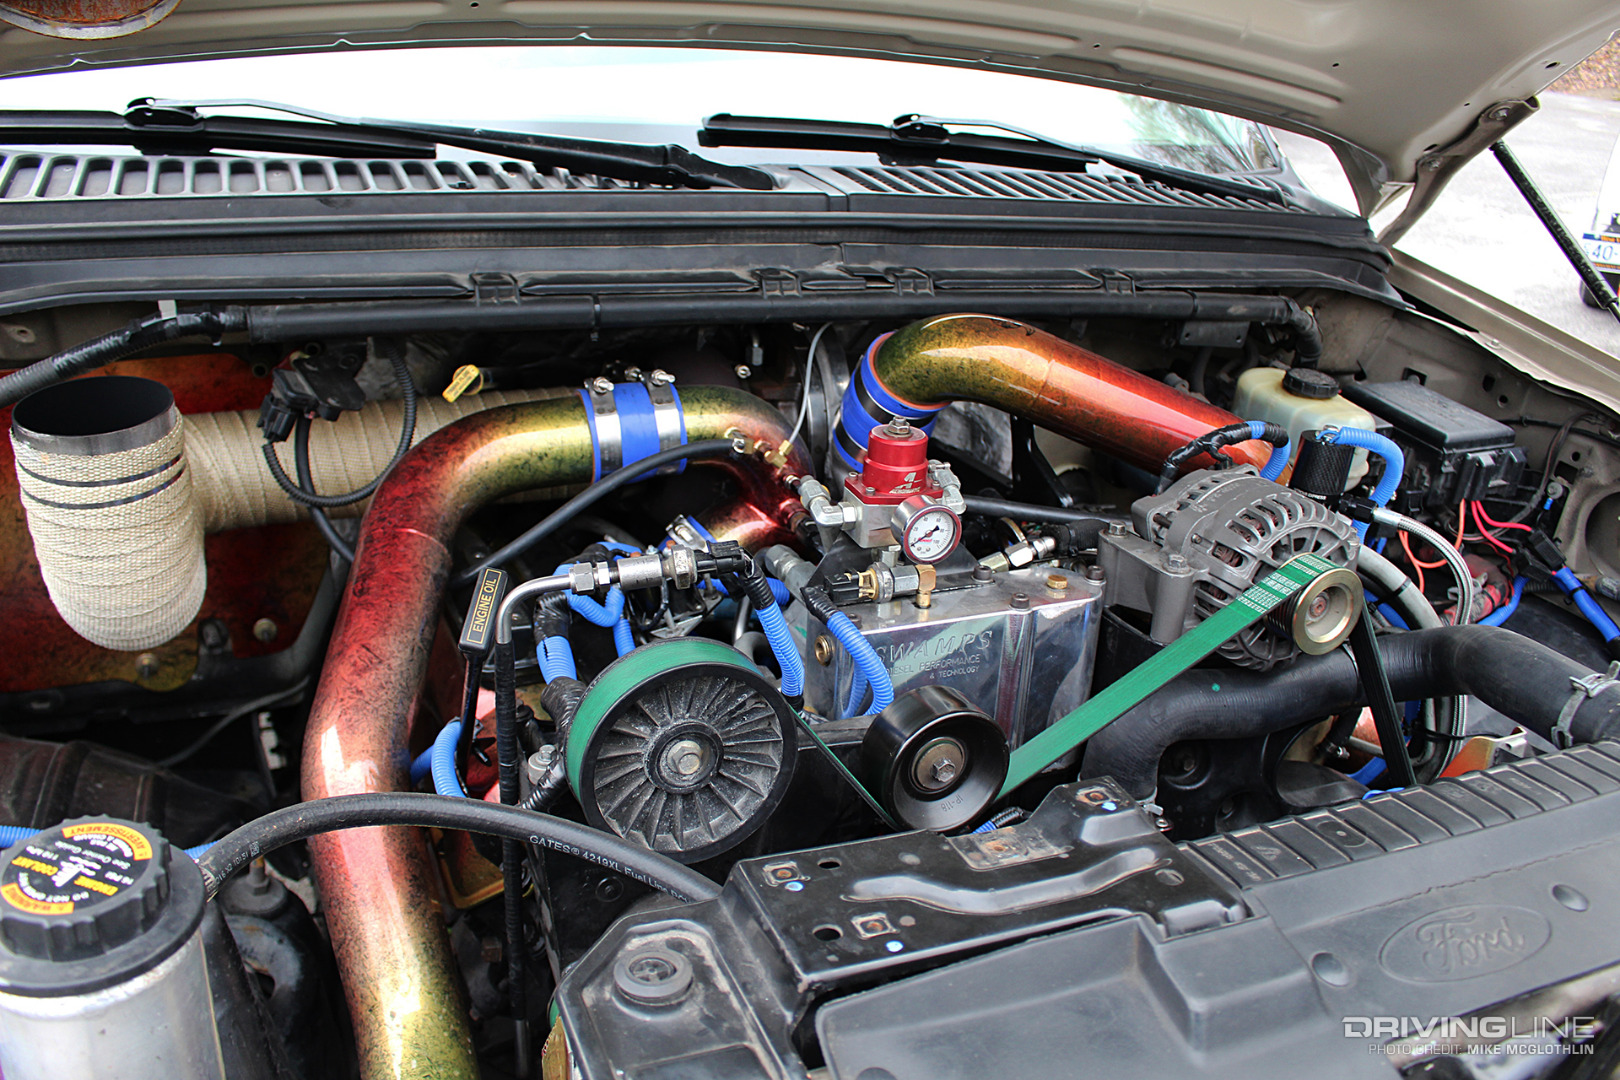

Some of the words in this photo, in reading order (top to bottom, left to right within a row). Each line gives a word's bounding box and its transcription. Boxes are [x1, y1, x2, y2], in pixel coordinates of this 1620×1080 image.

[472, 594, 492, 633] ENGINE
[483, 578, 497, 593] OIL
[919, 653, 981, 671] PERFORMANCE
[938, 664, 980, 678] TECHNOLOGY
[940, 794, 963, 811] IP-118
[54, 839, 82, 854] Guide
[70, 826, 146, 849] AVERTISSEMENT
[81, 849, 112, 864] Owner
[110, 857, 131, 870] See
[11, 856, 59, 876] COOLANT
[582, 851, 622, 873] 4219XL
[624, 866, 646, 883] Fuel
[649, 877, 669, 894] Line
[104, 870, 122, 882] PSI
[73, 875, 119, 896] ENGINE
[1415, 911, 1525, 974] Ford
